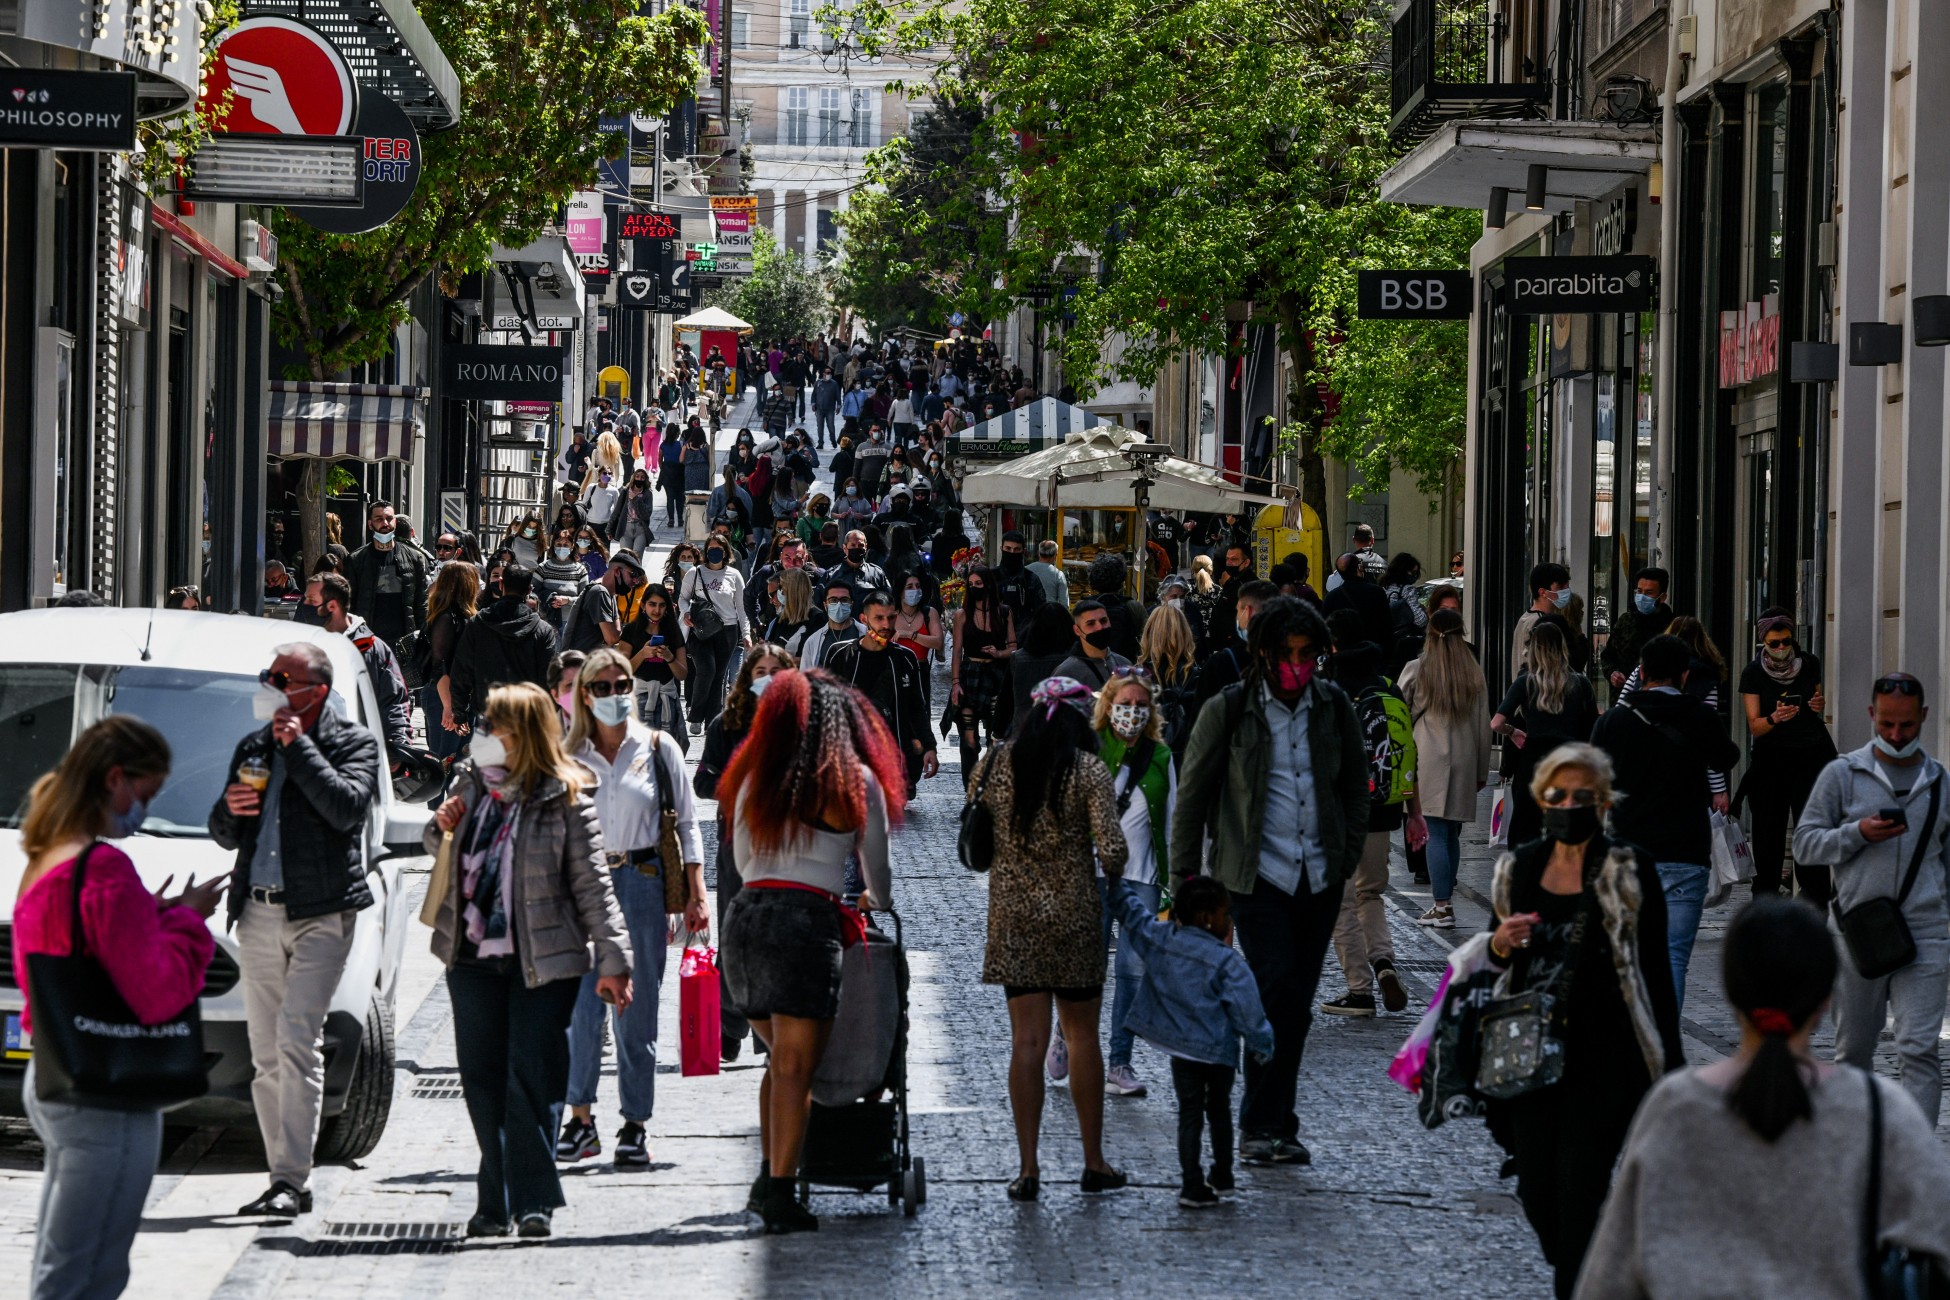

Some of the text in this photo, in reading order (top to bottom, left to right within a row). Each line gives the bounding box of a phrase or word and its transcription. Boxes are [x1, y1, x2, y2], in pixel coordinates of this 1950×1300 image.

[713, 197, 751, 205] ΑΓΟΡΑ
[626, 215, 671, 226] ΑΓΟΡΑ
[568, 223, 585, 234] LON
[623, 226, 676, 237] ΧΡΥΣΟΥ
[1515, 273, 1624, 299] parabita
[1381, 280, 1447, 310] BSB
[538, 317, 563, 327] dot.
[457, 363, 558, 382] ROMANO
[960, 440, 1029, 451] ERMOU Flower
[6, 1033, 19, 1043] GR
